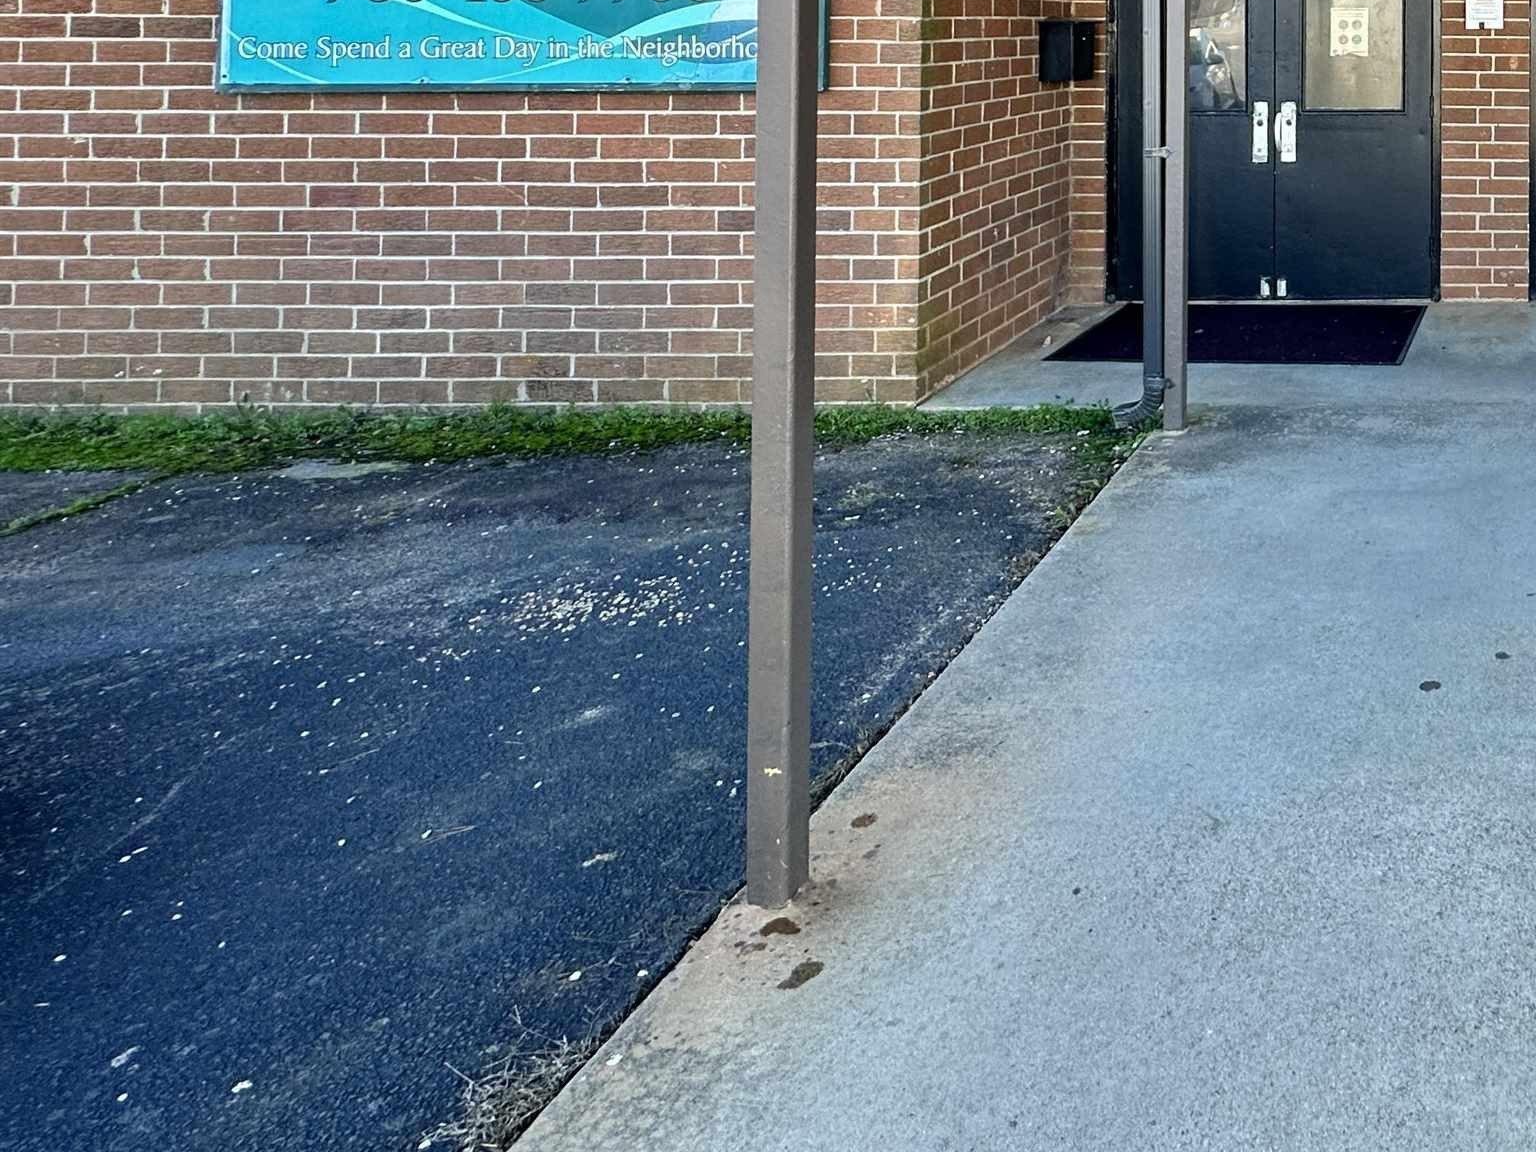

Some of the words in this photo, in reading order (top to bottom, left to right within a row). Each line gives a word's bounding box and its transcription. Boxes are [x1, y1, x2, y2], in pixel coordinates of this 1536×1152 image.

[238, 36, 307, 59] Come
[316, 35, 390, 67] Spend
[398, 42, 411, 59] a
[420, 35, 486, 59] Great
[495, 36, 542, 66] Day
[550, 36, 569, 58] in
[577, 35, 613, 58] the
[622, 35, 758, 66] Neighborho
